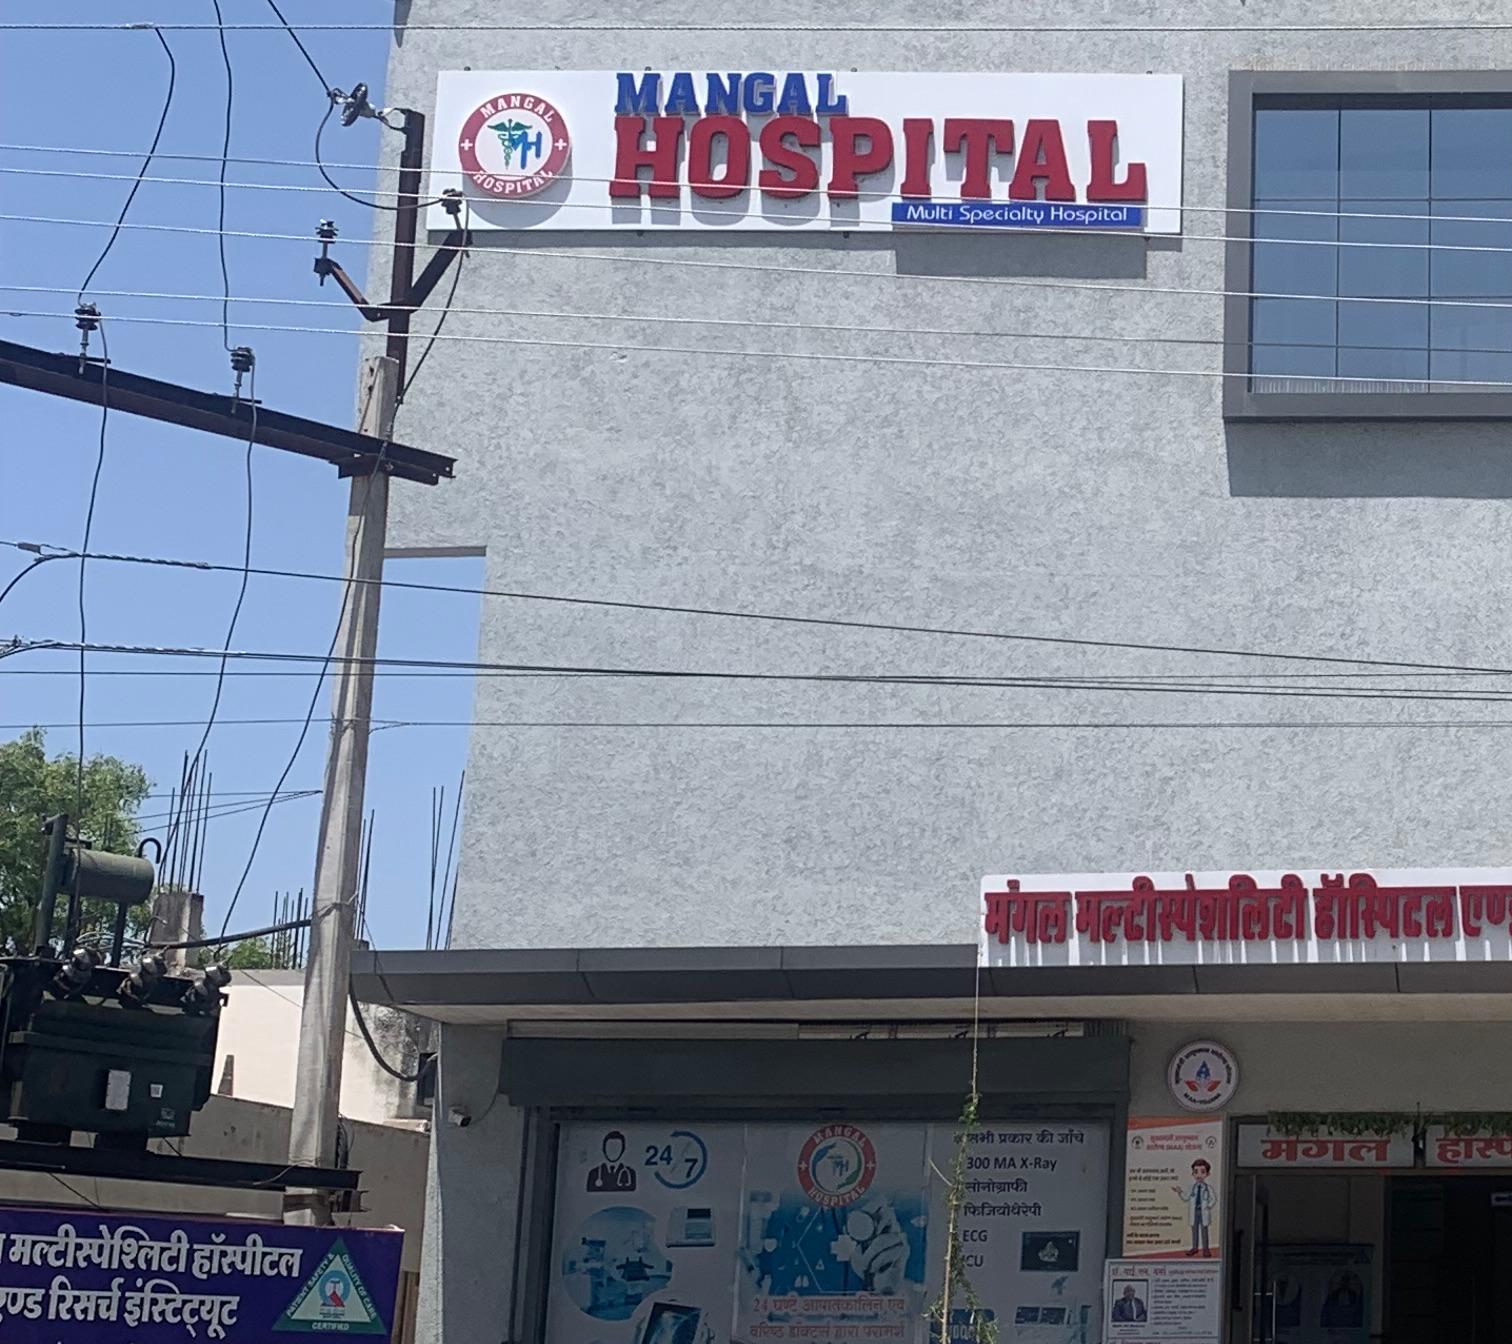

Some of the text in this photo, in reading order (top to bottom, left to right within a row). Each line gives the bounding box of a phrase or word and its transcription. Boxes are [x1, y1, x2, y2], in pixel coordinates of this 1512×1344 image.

[614, 72, 848, 115] MANGAL
[479, 95, 556, 122] MANGAL
[609, 115, 1149, 203] HOSPITAL
[473, 169, 553, 194] HOSPITAL
[906, 204, 1127, 224] Multi Specialty Hospital
[984, 879, 1072, 945] मंगल
[1313, 872, 1457, 940] हॉस्पिटल
[812, 1126, 867, 1149] MANGAL
[1037, 1129, 1054, 1144] की
[966, 1157, 1057, 1171] 300 MA X-Ray
[808, 1185, 866, 1207] HOSPITAL
[963, 1230, 987, 1242] ECG
[191, 1232, 303, 1279] हॉस्पीटल
[49, 1274, 124, 1322] रिसर्च
[311, 1322, 350, 1331] CERTIFIED
